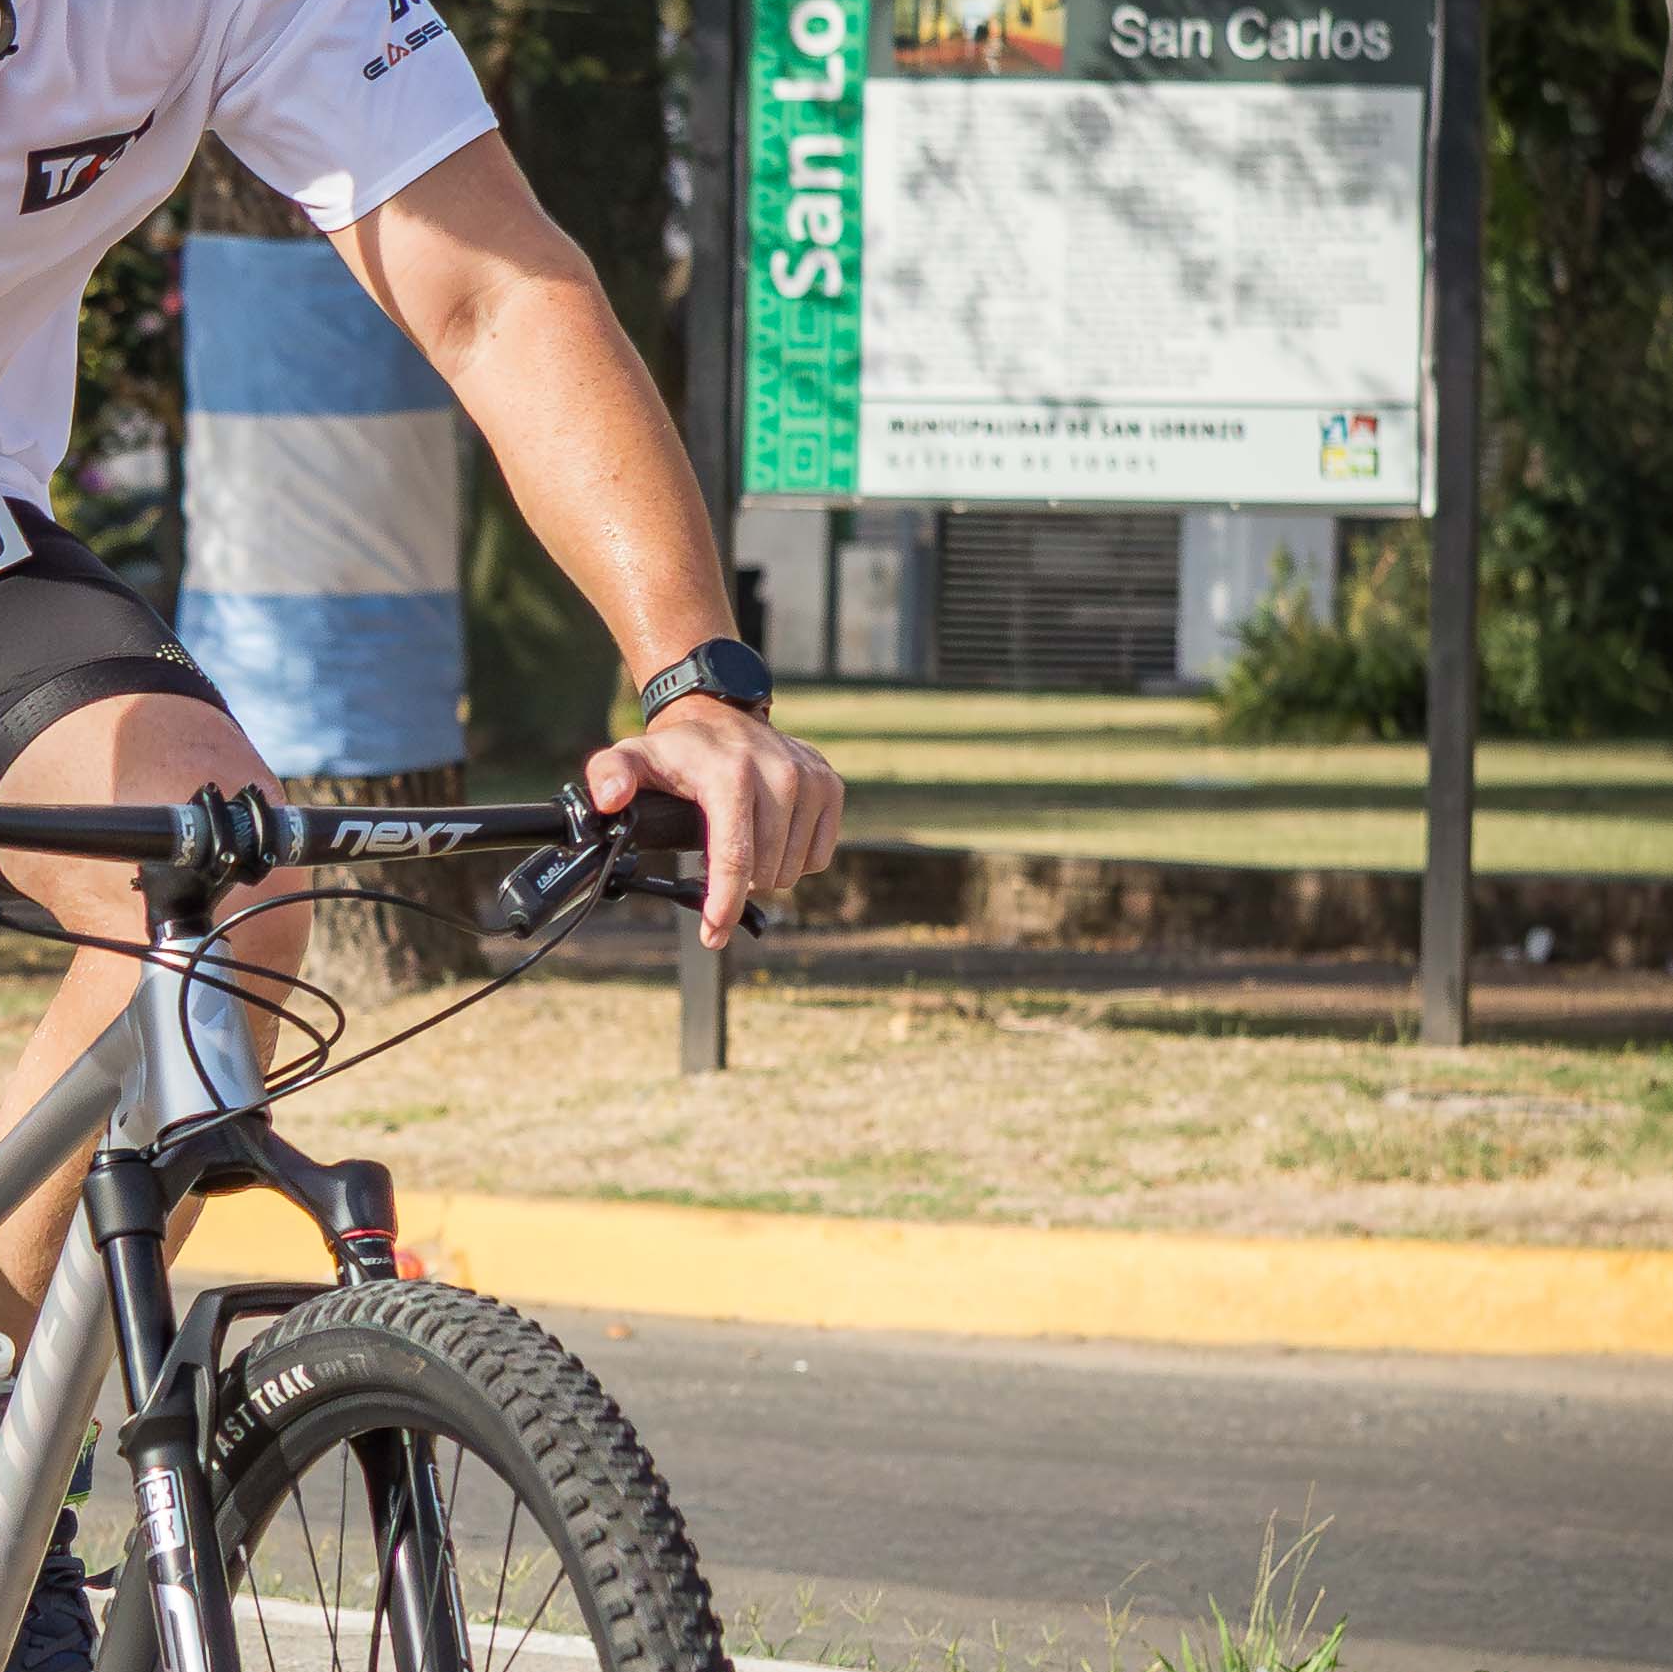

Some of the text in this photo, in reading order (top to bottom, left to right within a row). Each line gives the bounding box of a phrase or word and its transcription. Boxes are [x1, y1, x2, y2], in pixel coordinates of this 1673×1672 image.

[1109, 5, 1392, 61] San Carlos
[771, 135, 845, 300] San
[212, 1403, 256, 1471] AST
[249, 1363, 317, 1415] TRAK
